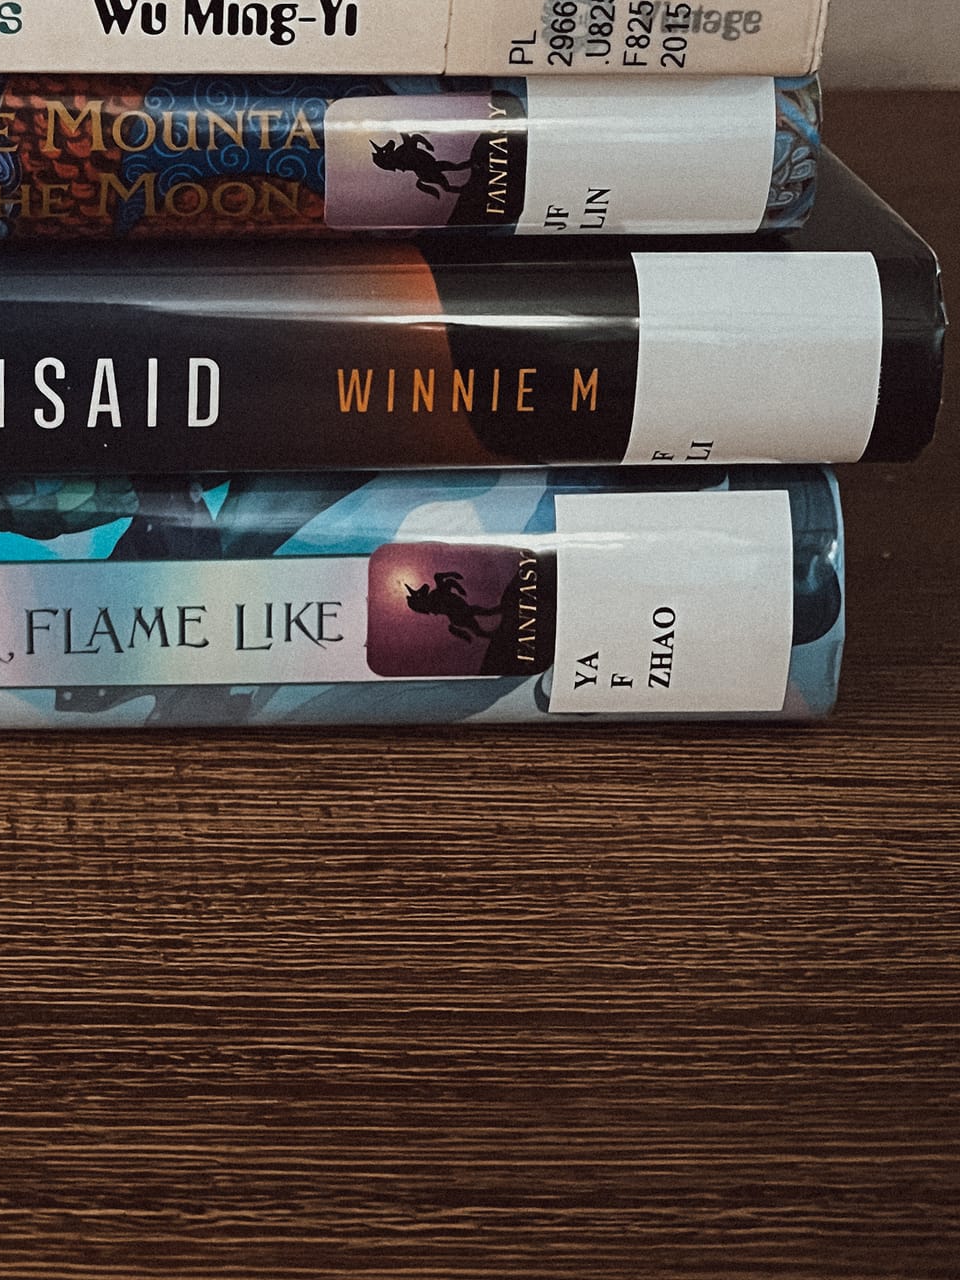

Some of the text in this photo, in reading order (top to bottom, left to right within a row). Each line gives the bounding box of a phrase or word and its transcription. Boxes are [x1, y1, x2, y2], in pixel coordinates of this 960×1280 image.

[508, 29, 538, 65] PL
[547, 0, 579, 67] 2966
[660, 2, 692, 68] 2015
[42, 99, 323, 154] MOUNTA
[98, 173, 306, 220] MOON
[543, 204, 570, 231] JF
[579, 187, 612, 230] LIN
[337, 367, 599, 414] WINNIE M
[651, 450, 675, 461] F
[684, 440, 714, 461] LI
[24, 604, 211, 657] FLAME
[233, 601, 345, 651] LIKE
[516, 550, 539, 662] FANTASY
[573, 650, 600, 691] YA
[647, 606, 677, 690] ZHAO
[610, 672, 634, 690] F
